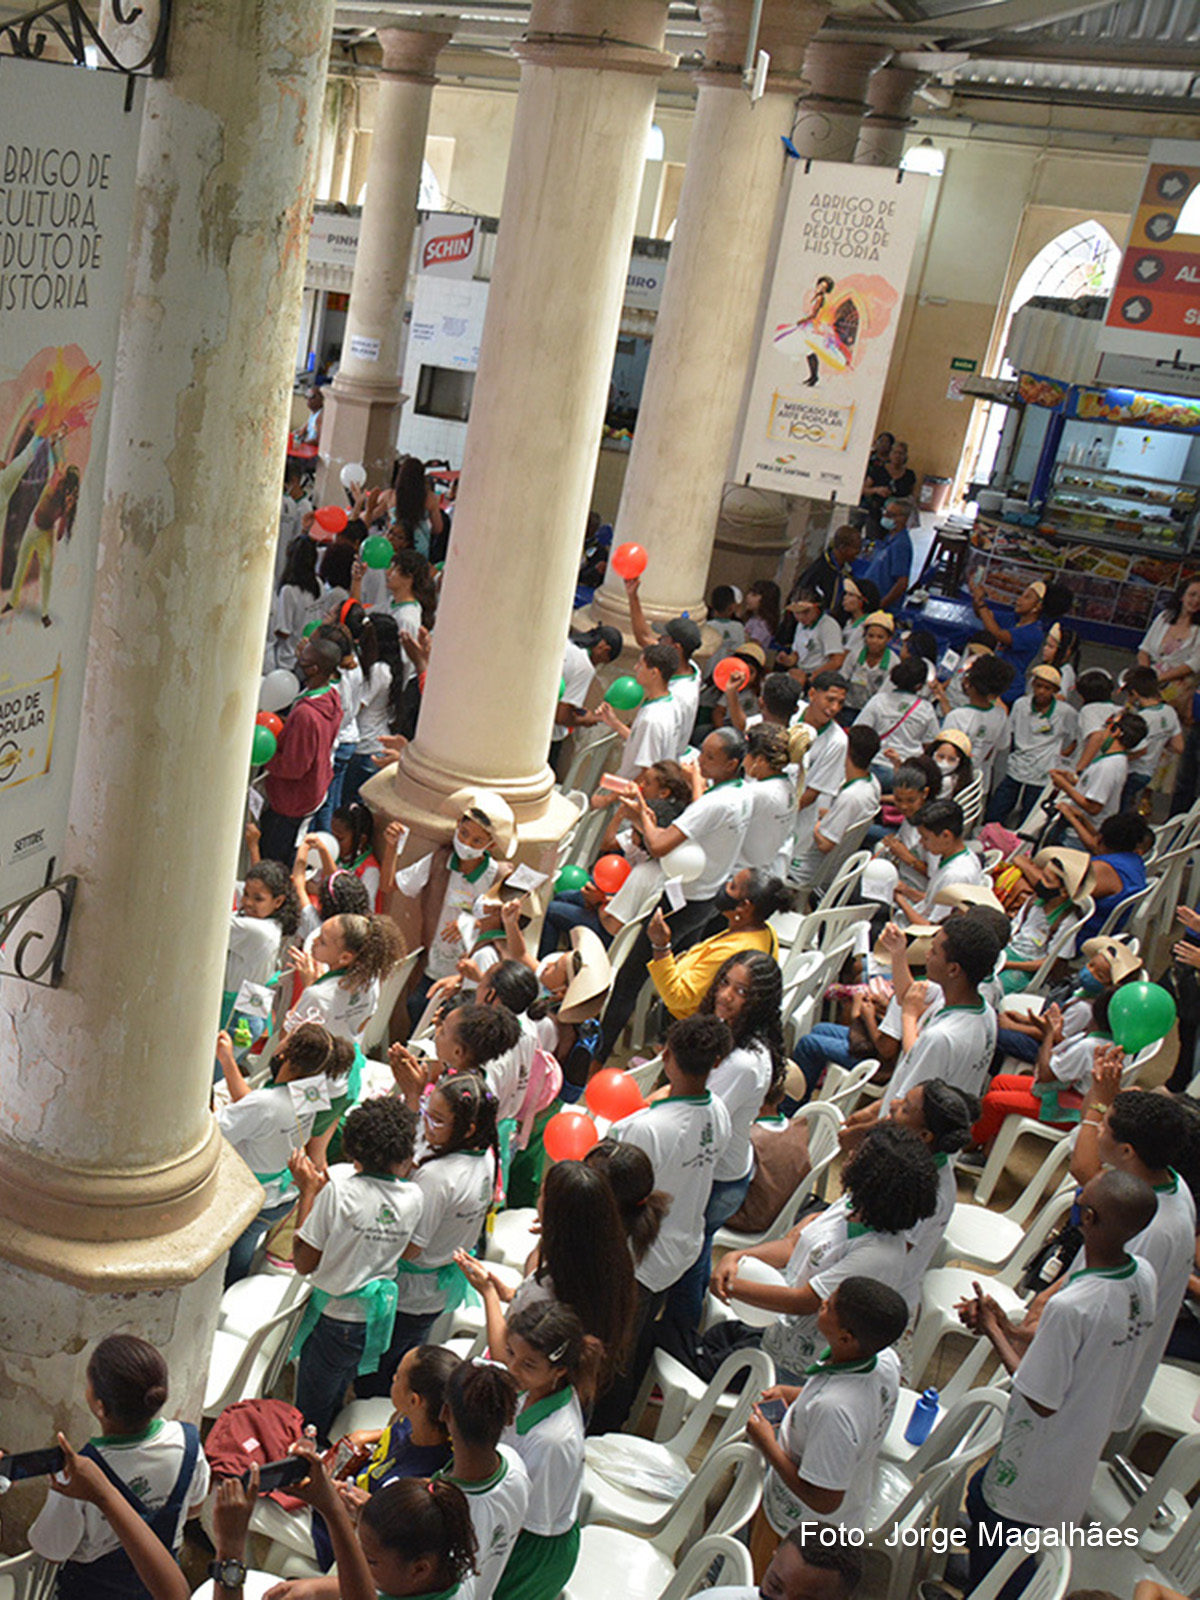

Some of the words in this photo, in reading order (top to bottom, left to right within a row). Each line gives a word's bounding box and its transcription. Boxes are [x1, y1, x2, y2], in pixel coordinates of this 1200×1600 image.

[87, 153, 111, 189] DE
[810, 193, 874, 214] ABRIGO
[878, 200, 896, 217] DE
[803, 222, 869, 244] REDUTO
[872, 231, 890, 247] DE
[79, 234, 102, 269] DE
[426, 237, 471, 260] SCHIN
[777, 410, 799, 421] ARTE
[801, 412, 843, 427] POPULAR
[784, 403, 826, 416] MERCADO
[828, 408, 840, 419] DE
[25, 691, 41, 712] DE
